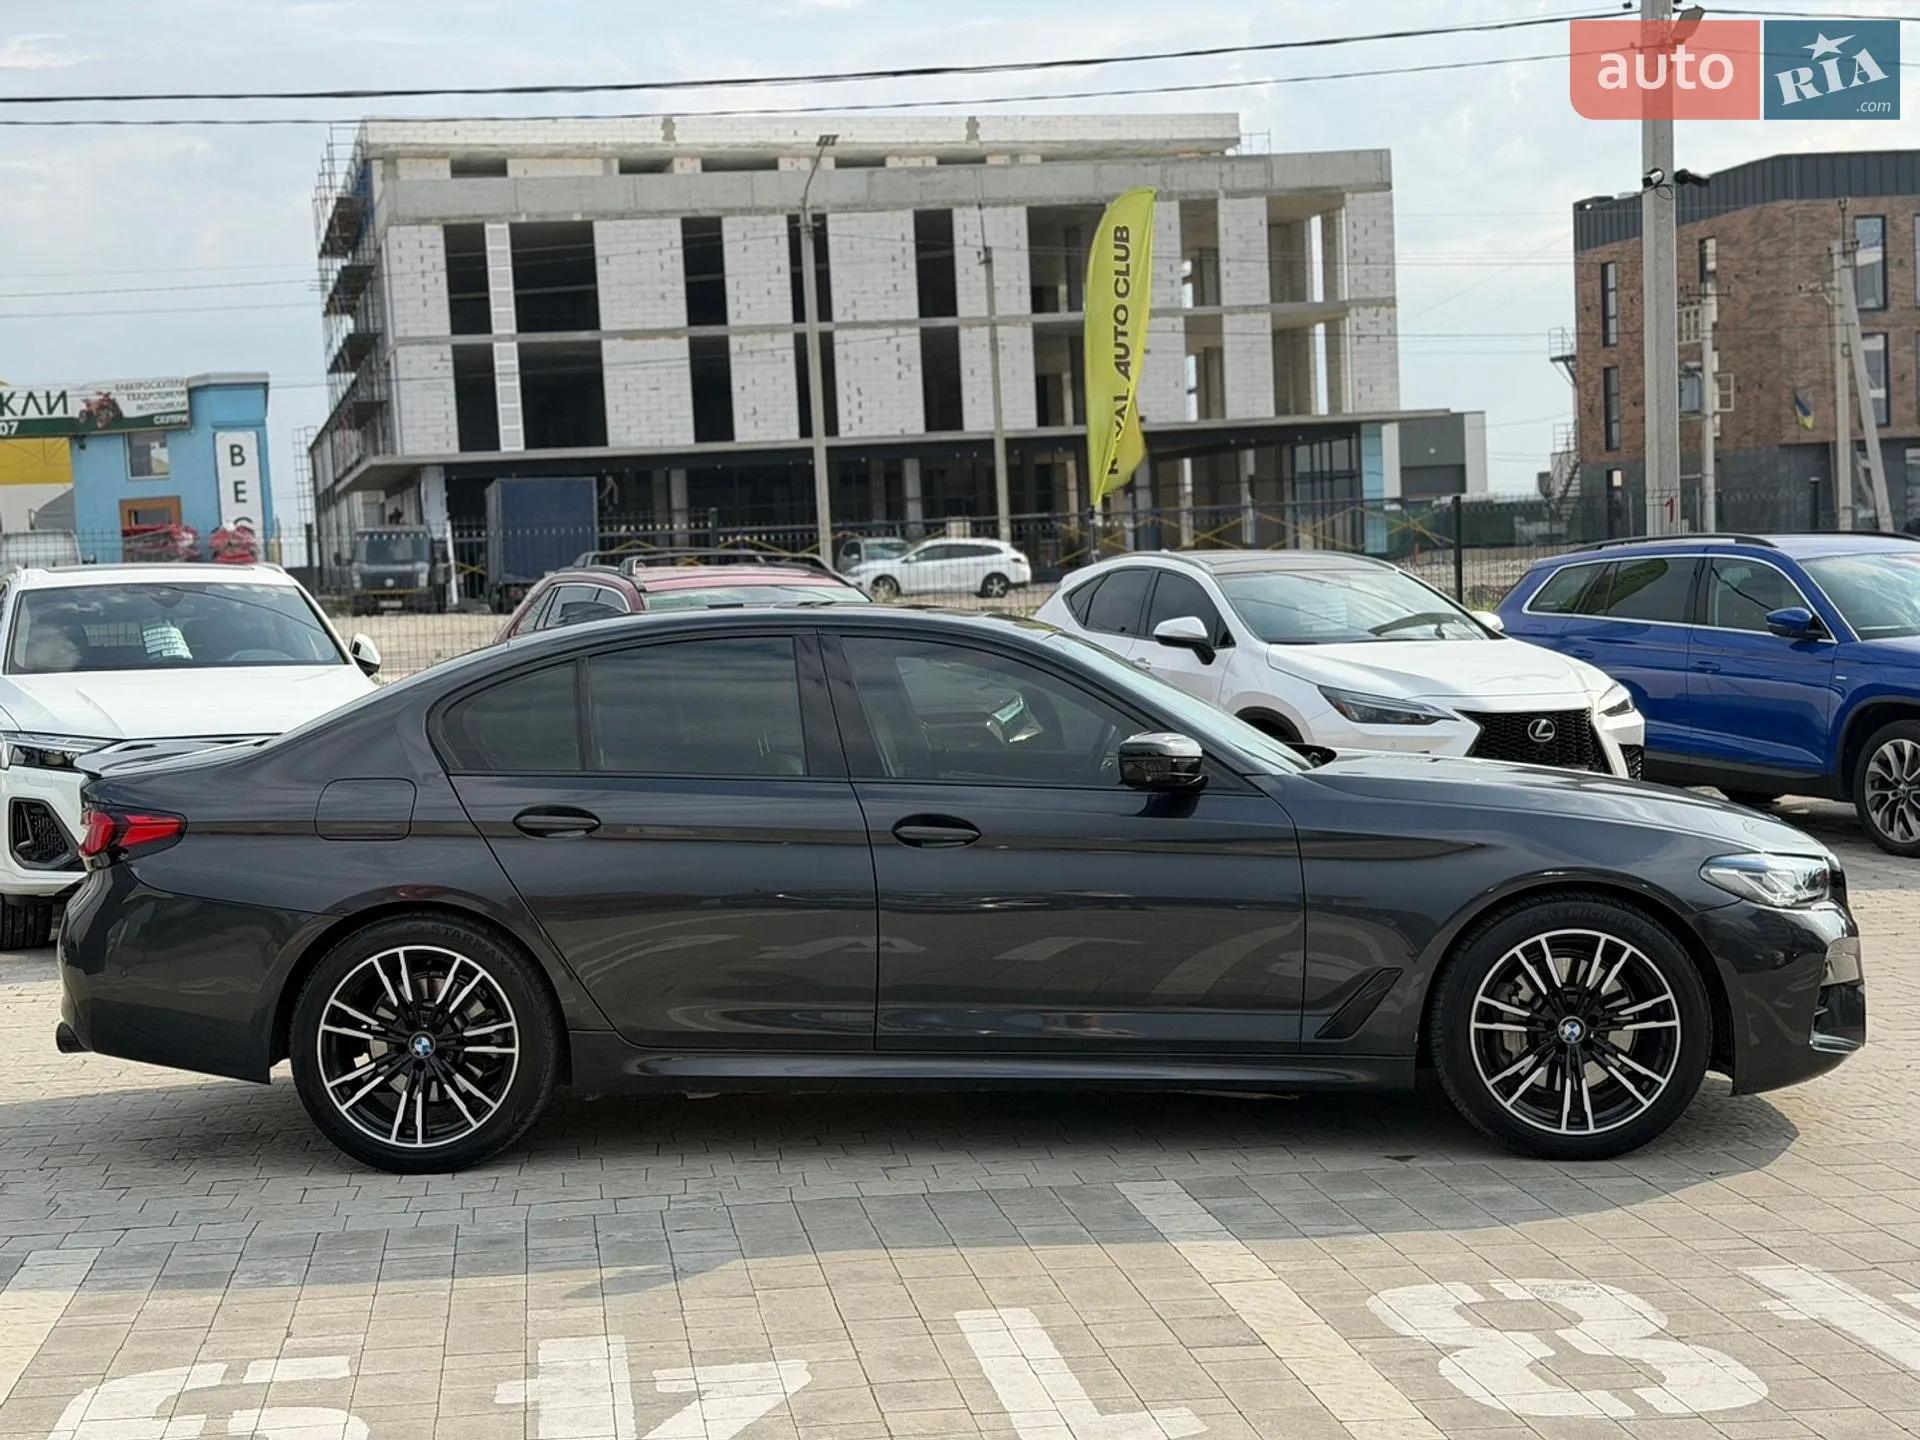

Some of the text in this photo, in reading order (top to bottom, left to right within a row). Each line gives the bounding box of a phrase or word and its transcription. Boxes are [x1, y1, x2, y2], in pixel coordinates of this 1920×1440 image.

[1113, 225, 1131, 299] CLUB
[1113, 304, 1131, 382] AUTO
[229, 444, 253, 525] ВЕ
